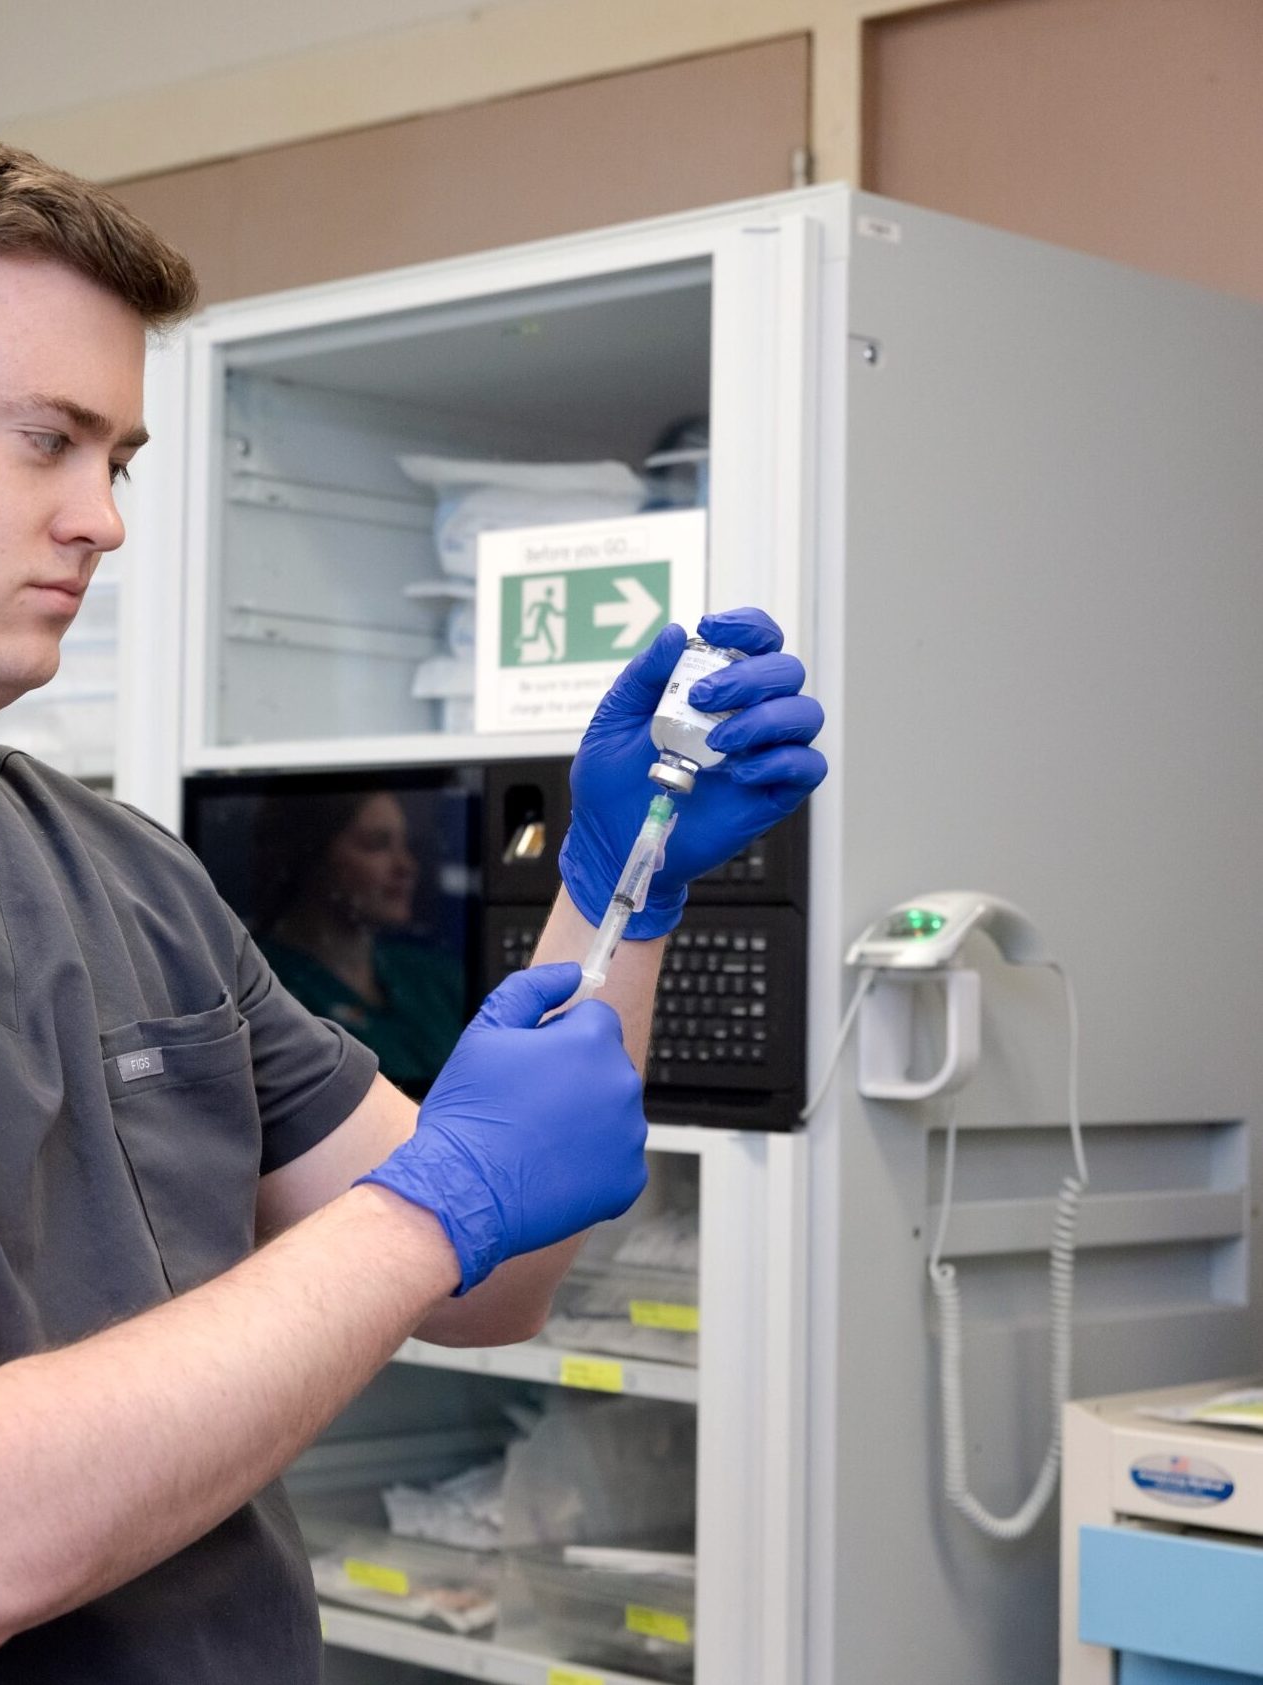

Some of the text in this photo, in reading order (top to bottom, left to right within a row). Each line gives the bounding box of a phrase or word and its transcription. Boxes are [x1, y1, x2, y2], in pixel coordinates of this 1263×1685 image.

[526, 544, 570, 562] Before
[574, 545, 600, 562] you
[519, 680, 532, 693] Be
[535, 682, 556, 692] sure
[559, 680, 570, 691] to
[510, 701, 544, 717] change
[546, 699, 563, 712] the
[130, 1057, 150, 1072] FIGS
